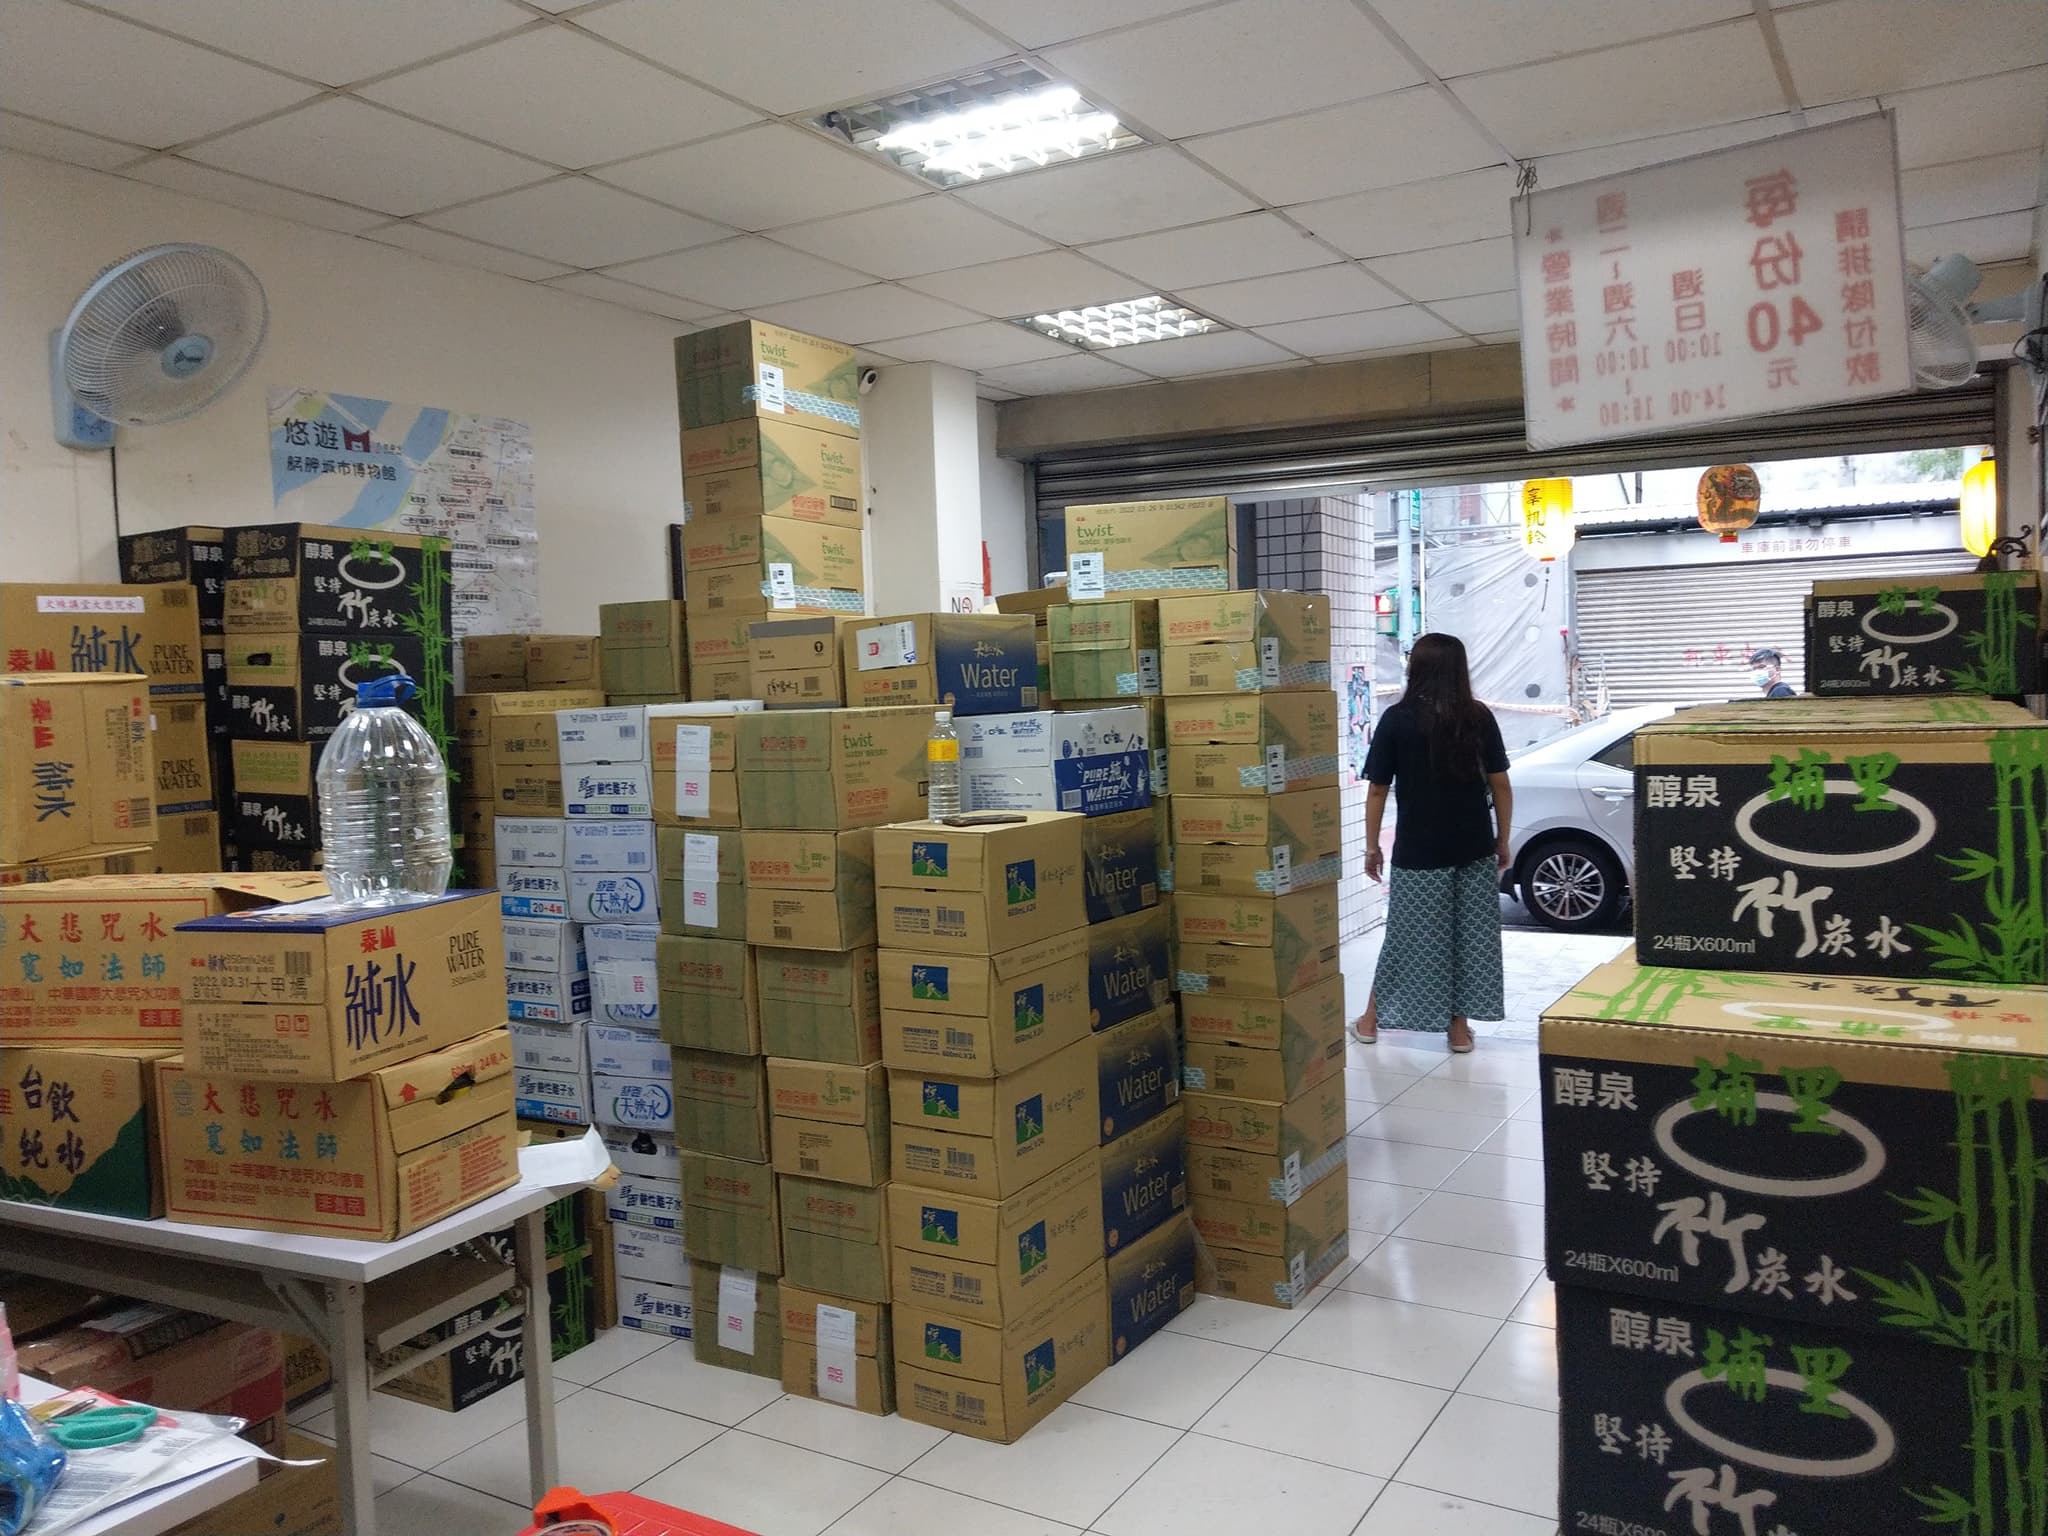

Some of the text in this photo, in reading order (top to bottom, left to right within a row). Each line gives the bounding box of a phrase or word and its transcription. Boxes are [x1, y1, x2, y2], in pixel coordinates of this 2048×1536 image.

[760, 341, 788, 359] twist
[284, 417, 339, 451] 悠遊
[1077, 524, 1115, 538] twist
[1741, 536, 1852, 555] 車庫前請勿停車
[304, 542, 335, 560] 醇泉
[351, 536, 395, 566] 埔里
[313, 576, 342, 594] 堅持
[1879, 585, 1943, 616] 埔里
[1817, 600, 1855, 618] 醇泉
[153, 644, 189, 660] PURE
[318, 640, 348, 657] 醇泉
[351, 641, 395, 669] 埔里
[1828, 635, 1865, 653] 堅持
[8, 648, 57, 672] 泰山
[150, 660, 194, 676] WATER
[960, 664, 1019, 689] Water
[312, 684, 342, 701] 堅持
[30, 698, 55, 750] 泰山
[843, 733, 874, 750] twist
[161, 758, 196, 774] PURE
[1083, 767, 1110, 784] PURE
[1767, 748, 1901, 812] 埔里
[32, 760, 76, 823] 純水
[157, 774, 202, 791] WATER
[1085, 783, 1120, 802] WATER
[1646, 773, 1722, 809] 醇泉
[1669, 845, 1742, 882] 堅持
[1087, 863, 1139, 897] Water
[595, 892, 634, 914] 天然水
[1731, 870, 1912, 959] 竹炭水
[19, 910, 169, 943] 大悲咒水
[360, 925, 397, 954] 泰山
[449, 929, 481, 951] PURE
[1653, 934, 1756, 955] 24瓶X600ml
[20, 952, 167, 984] 寬如法師
[446, 949, 485, 975] WATER
[1103, 963, 1151, 1000] Water
[344, 953, 421, 1051] 純水
[19, 1063, 80, 1125] 台飲
[202, 1080, 340, 1122] 大悲咒水
[1117, 1066, 1163, 1107] Water
[1552, 1066, 1640, 1113] 醇泉
[1689, 1050, 1845, 1136] 埔里
[619, 1097, 661, 1121] 天然水
[19, 1128, 87, 1175] 純水
[205, 1123, 340, 1163] 寬如法師
[1580, 1150, 1662, 1198] 堅持
[1122, 1170, 1170, 1216] Water
[1652, 1190, 1859, 1306] 竹炭水
[1564, 1250, 1680, 1284] 24瓶X600ml
[1130, 1275, 1178, 1323] Water
[1608, 1306, 1696, 1359] 醇泉
[1700, 1326, 1853, 1420] 埔里
[1592, 1411, 1674, 1465] 堅持
